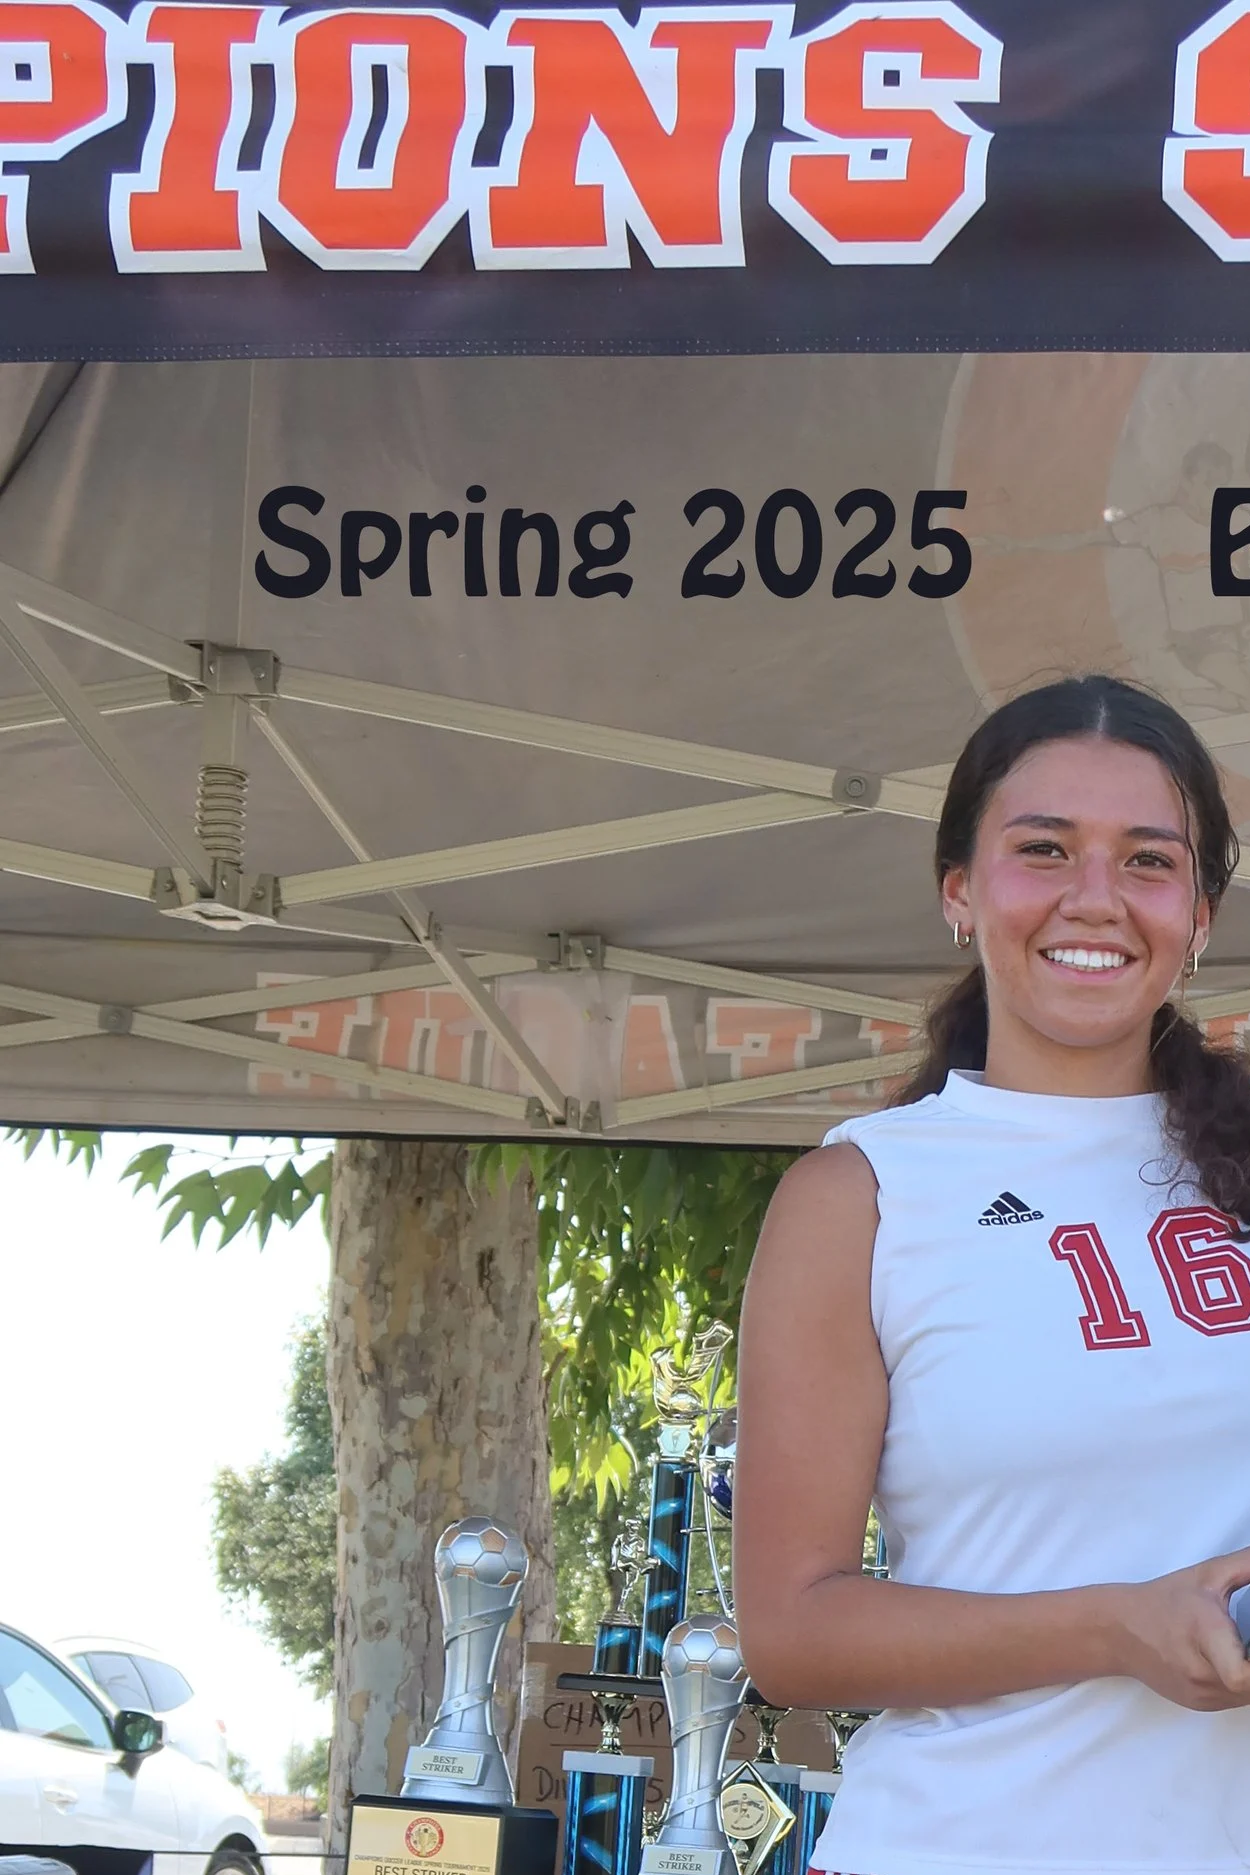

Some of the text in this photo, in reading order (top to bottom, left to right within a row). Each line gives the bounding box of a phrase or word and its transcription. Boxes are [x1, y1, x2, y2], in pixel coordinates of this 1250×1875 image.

[977, 1209, 1045, 1226] adidas
[432, 1755, 458, 1764] BEST
[421, 1763, 464, 1774] STRIKER
[669, 1853, 694, 1862] BEST
[658, 1861, 701, 1871] STRIKER
